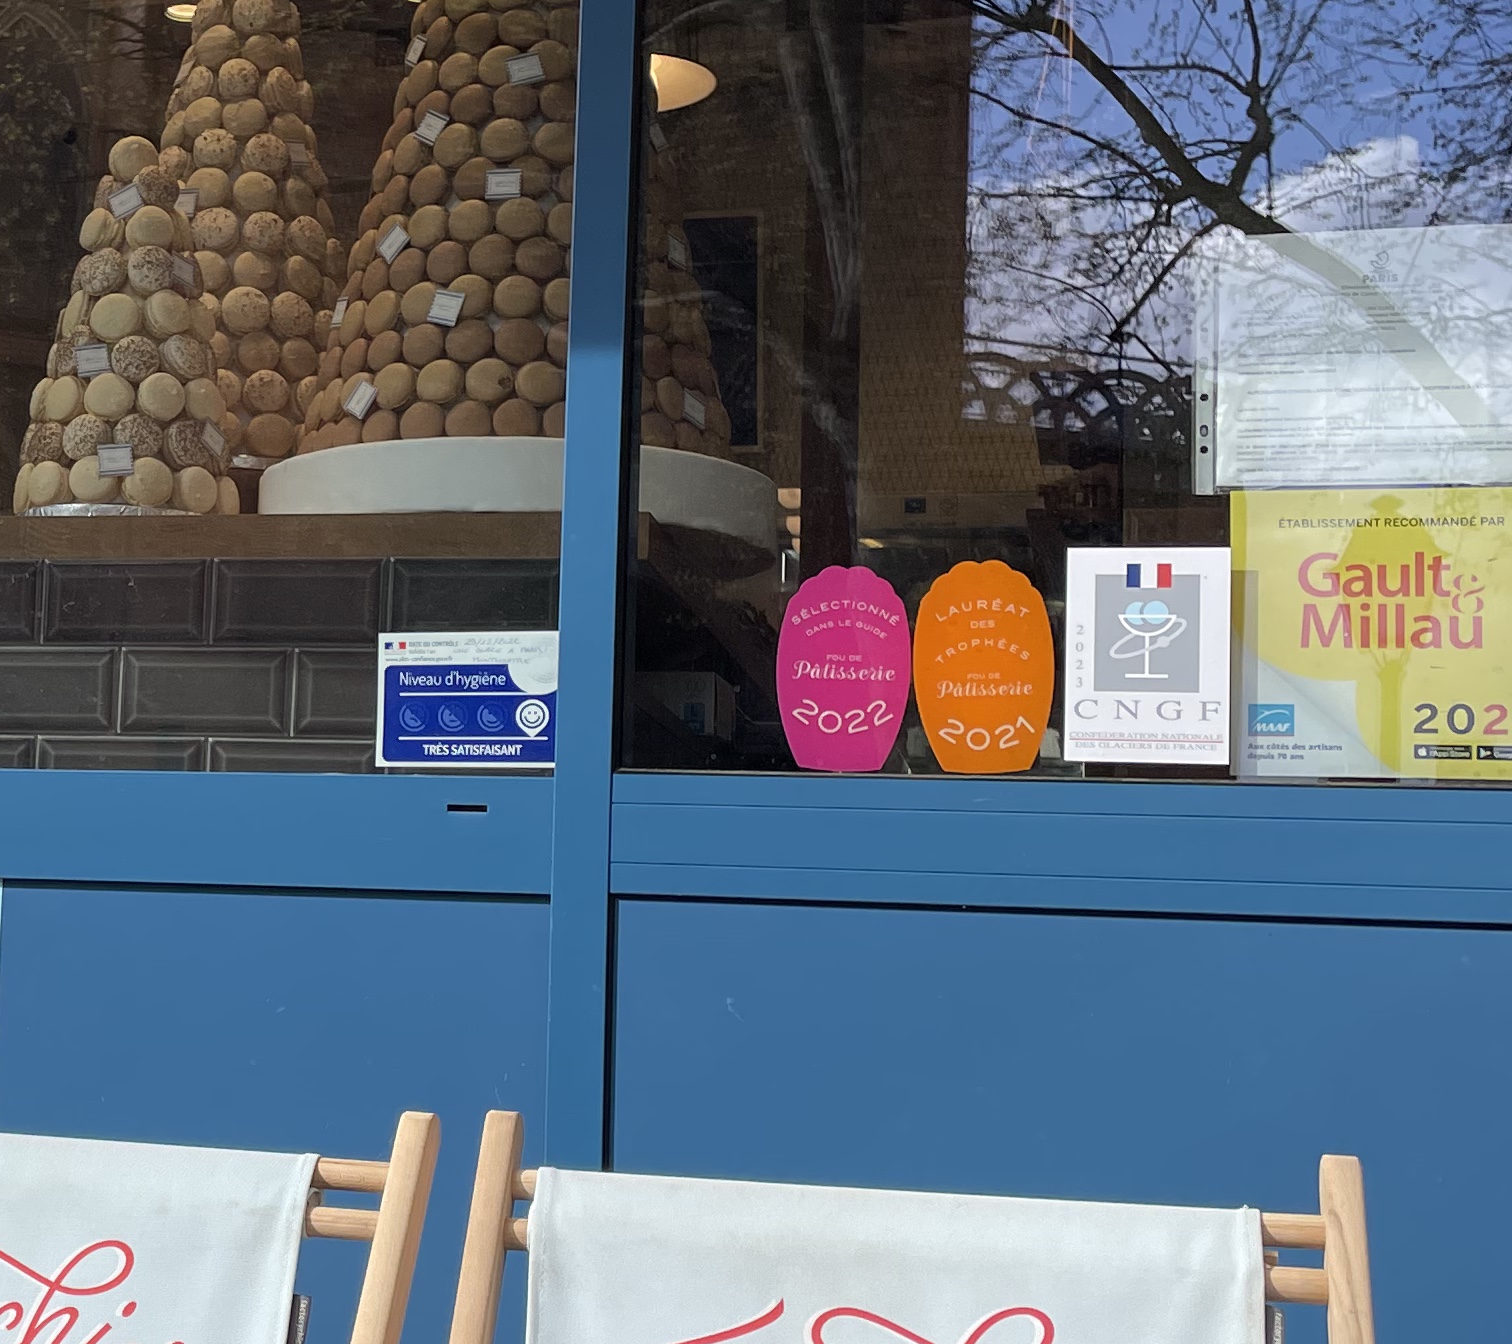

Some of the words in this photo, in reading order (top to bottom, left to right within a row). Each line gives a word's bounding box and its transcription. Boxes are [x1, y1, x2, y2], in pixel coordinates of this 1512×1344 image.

[1278, 517, 1381, 528] ÉTABLISSEMENT
[1384, 516, 1476, 528] RECOMMANDÉ
[1481, 516, 1505, 527] PAR
[1298, 551, 1451, 597] Gault
[791, 599, 900, 626] SÉLECTIONNÉ
[935, 598, 1030, 622] LAURÉAT
[805, 620, 834, 636] DANS
[855, 621, 887, 639] GUIDE
[970, 619, 995, 629] DES
[1300, 603, 1483, 650] Millau
[826, 654, 846, 662] FOU
[935, 638, 1030, 664] TROPHÉES
[399, 672, 442, 686] Niveau
[445, 670, 506, 690] d'hygiène
[792, 660, 896, 681] Pâtisserie
[967, 672, 985, 680] FOU
[936, 680, 1033, 699] Pâtisserie
[792, 699, 894, 734] 2022
[938, 715, 1035, 751] 2021
[1161, 732, 1223, 741] NATIONALE
[423, 742, 449, 755] TRÈS
[451, 744, 522, 755] SATISFAISANT
[1075, 741, 1096, 749] DES
[1098, 741, 1152, 750] GLACIERS
[1173, 743, 1217, 751] FRANCE
[1292, 742, 1306, 751] des
[1308, 743, 1343, 751] artisans
